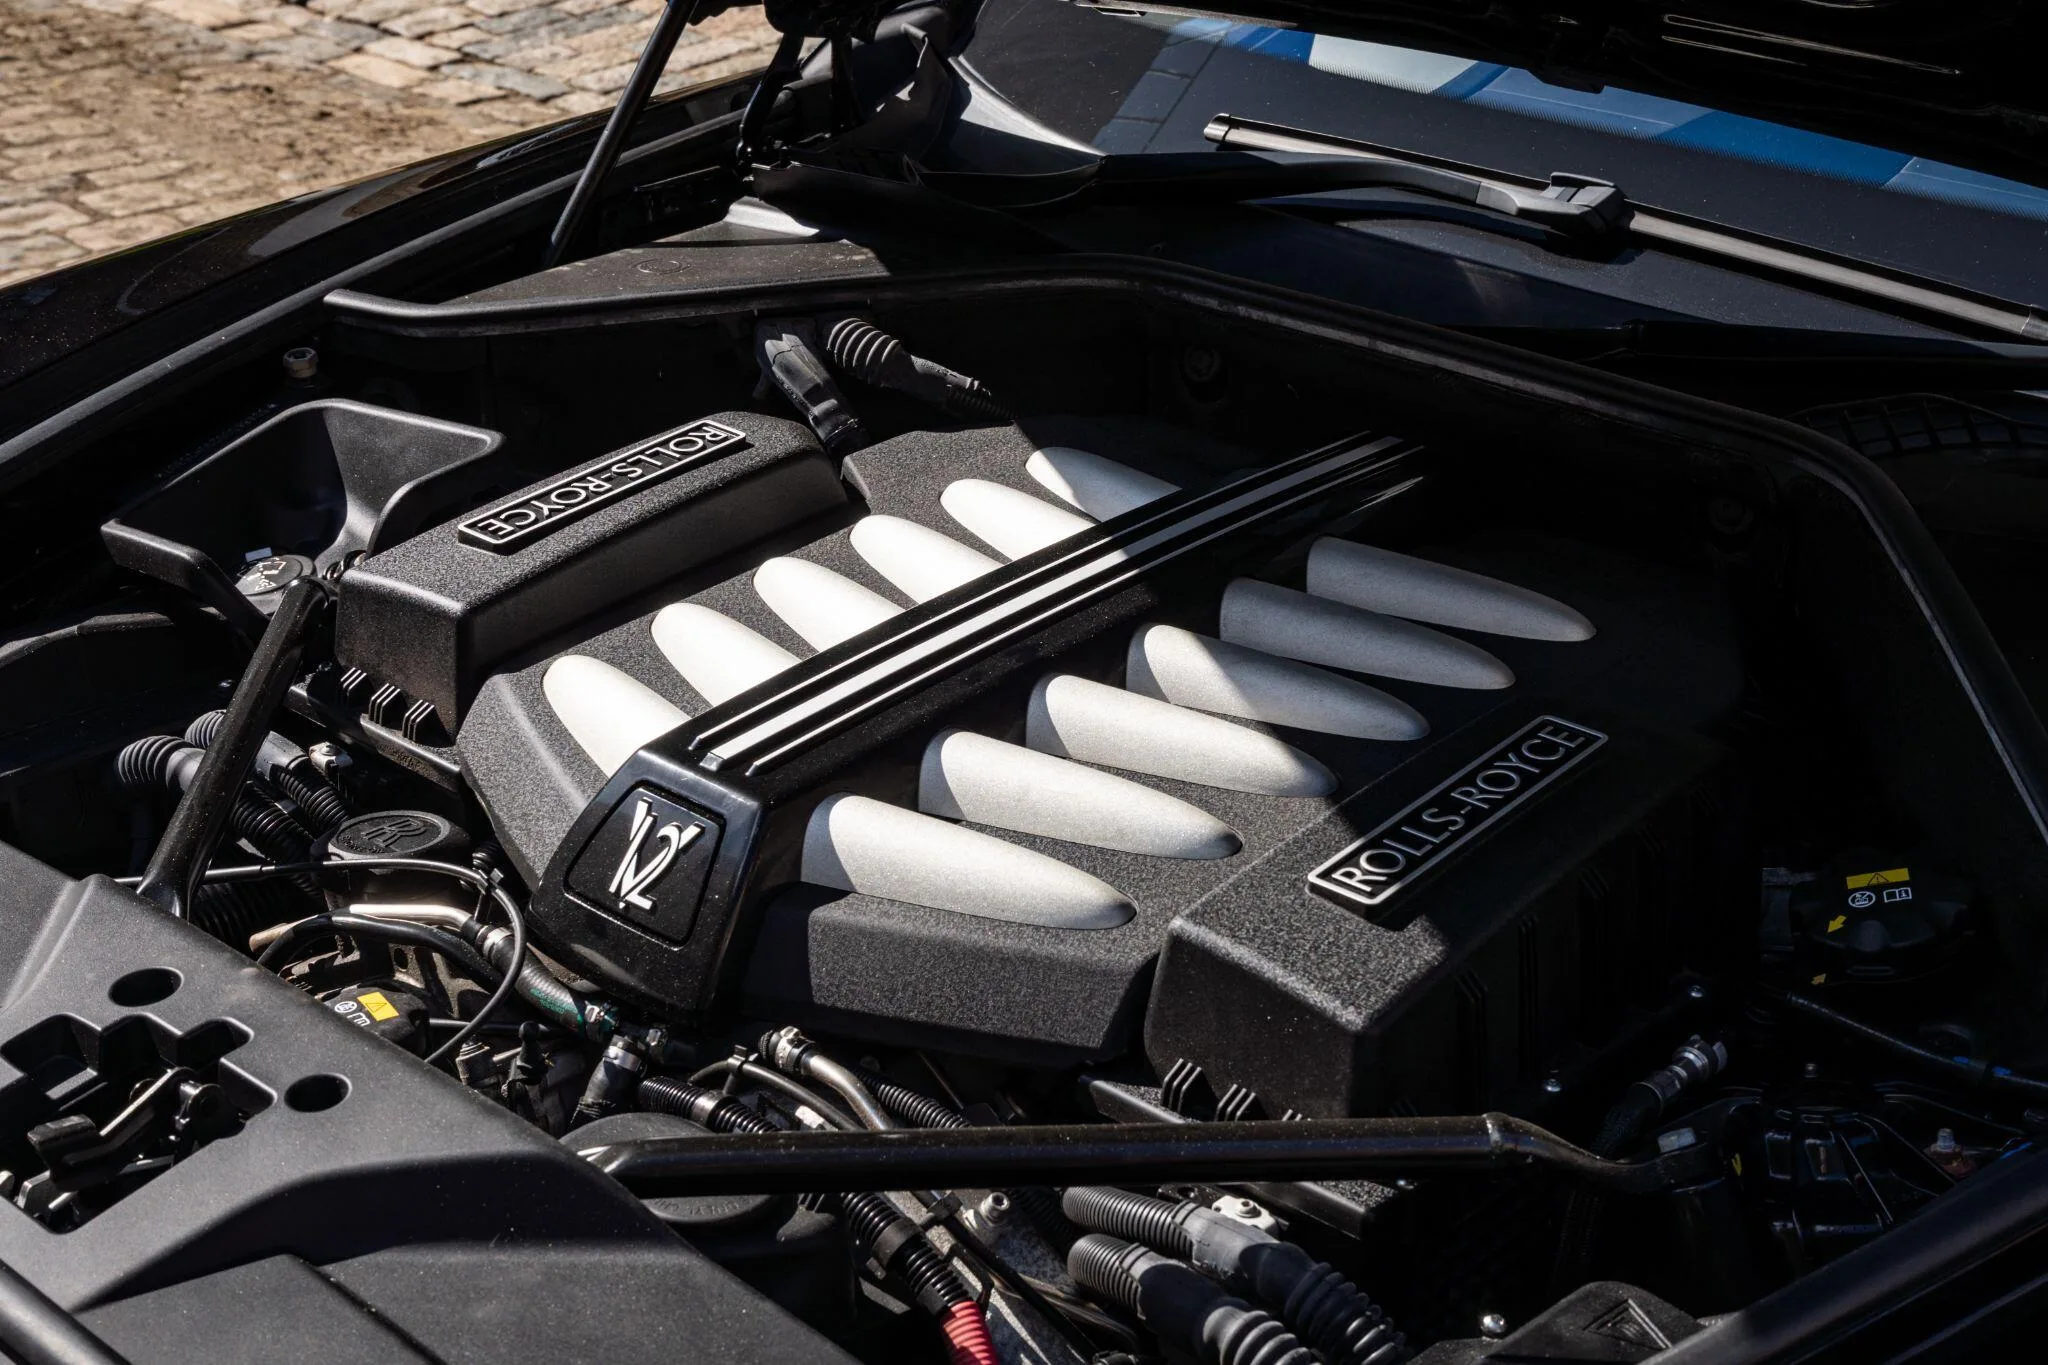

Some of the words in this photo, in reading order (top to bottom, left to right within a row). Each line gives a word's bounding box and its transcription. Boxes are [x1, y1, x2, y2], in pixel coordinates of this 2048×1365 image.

[476, 426, 728, 535] ROLLS-ROYCE
[608, 797, 702, 911] V12
[1331, 726, 1586, 892] ROLLS-ROYCE
